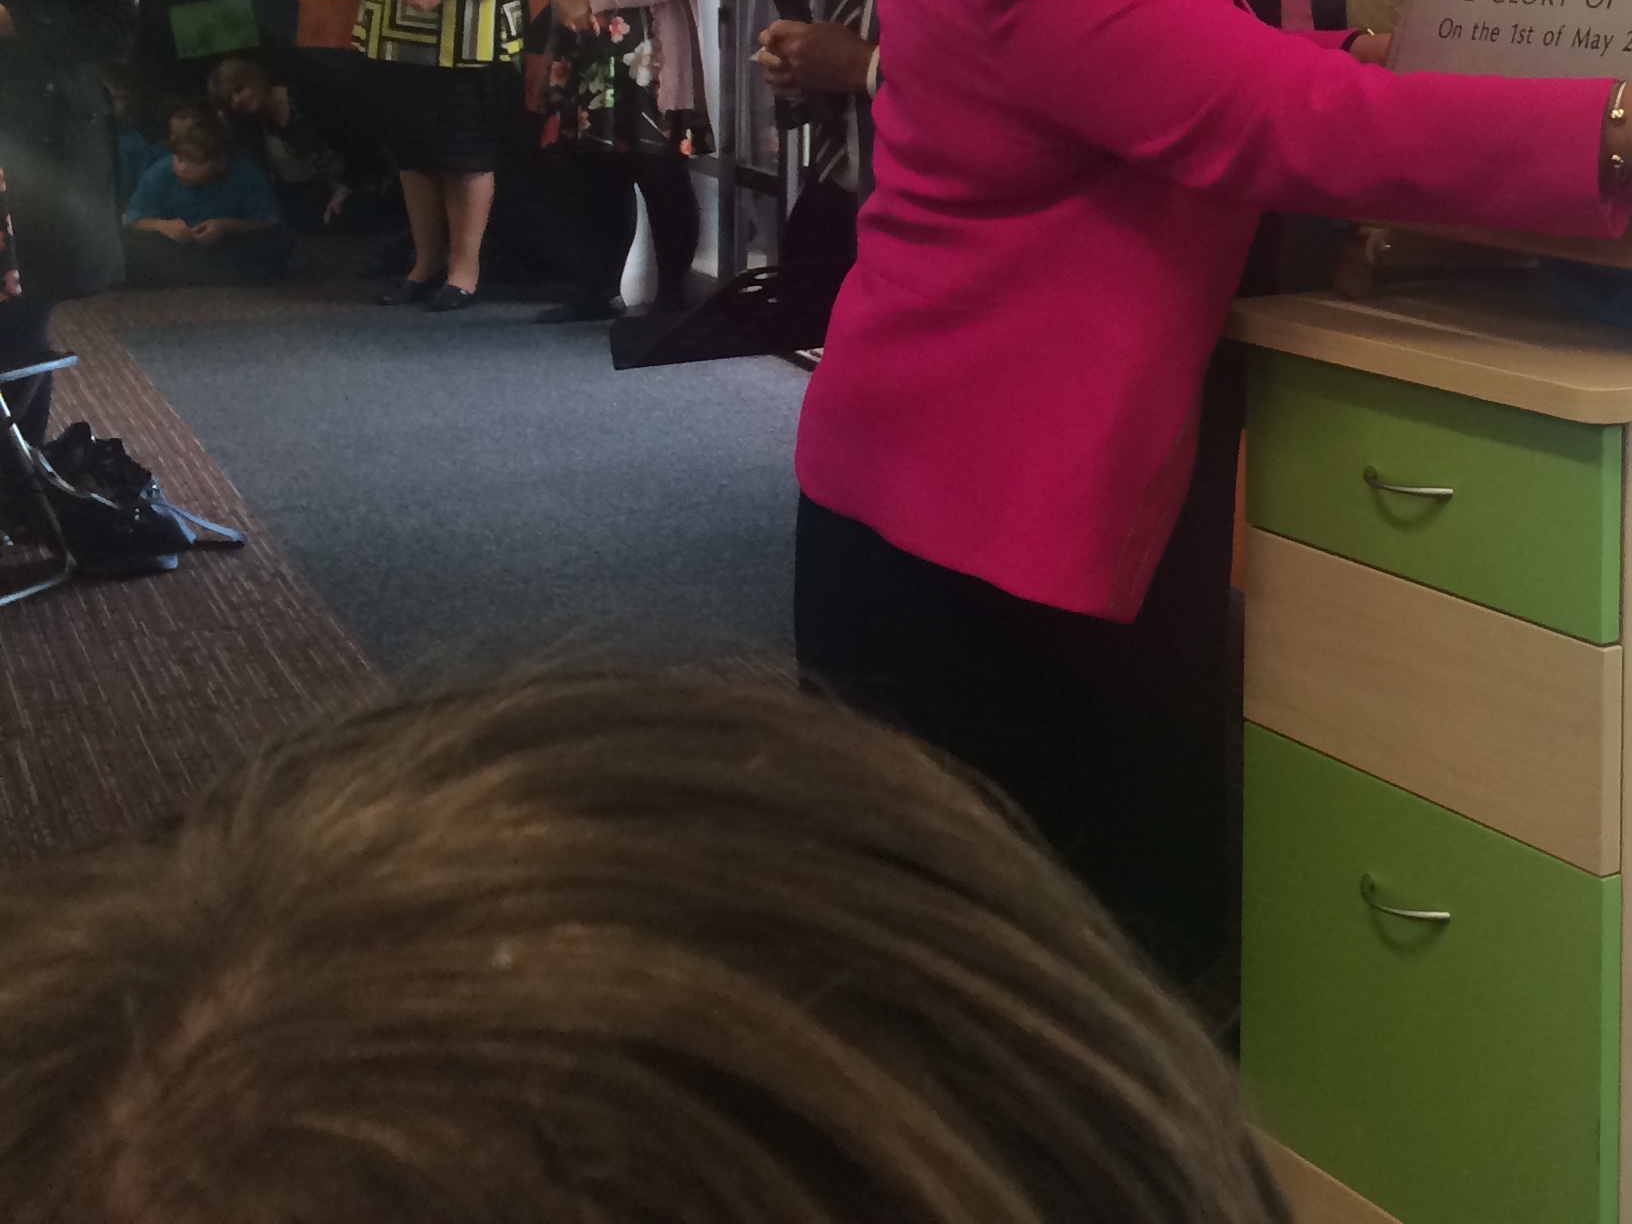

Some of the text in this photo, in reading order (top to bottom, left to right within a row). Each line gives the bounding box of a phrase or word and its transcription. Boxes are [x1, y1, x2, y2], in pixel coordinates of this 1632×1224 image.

[1438, 17, 1463, 40] On
[1471, 22, 1501, 43] the
[1510, 24, 1535, 46] 1st
[1542, 26, 1566, 47] of
[1572, 26, 1614, 57] May
